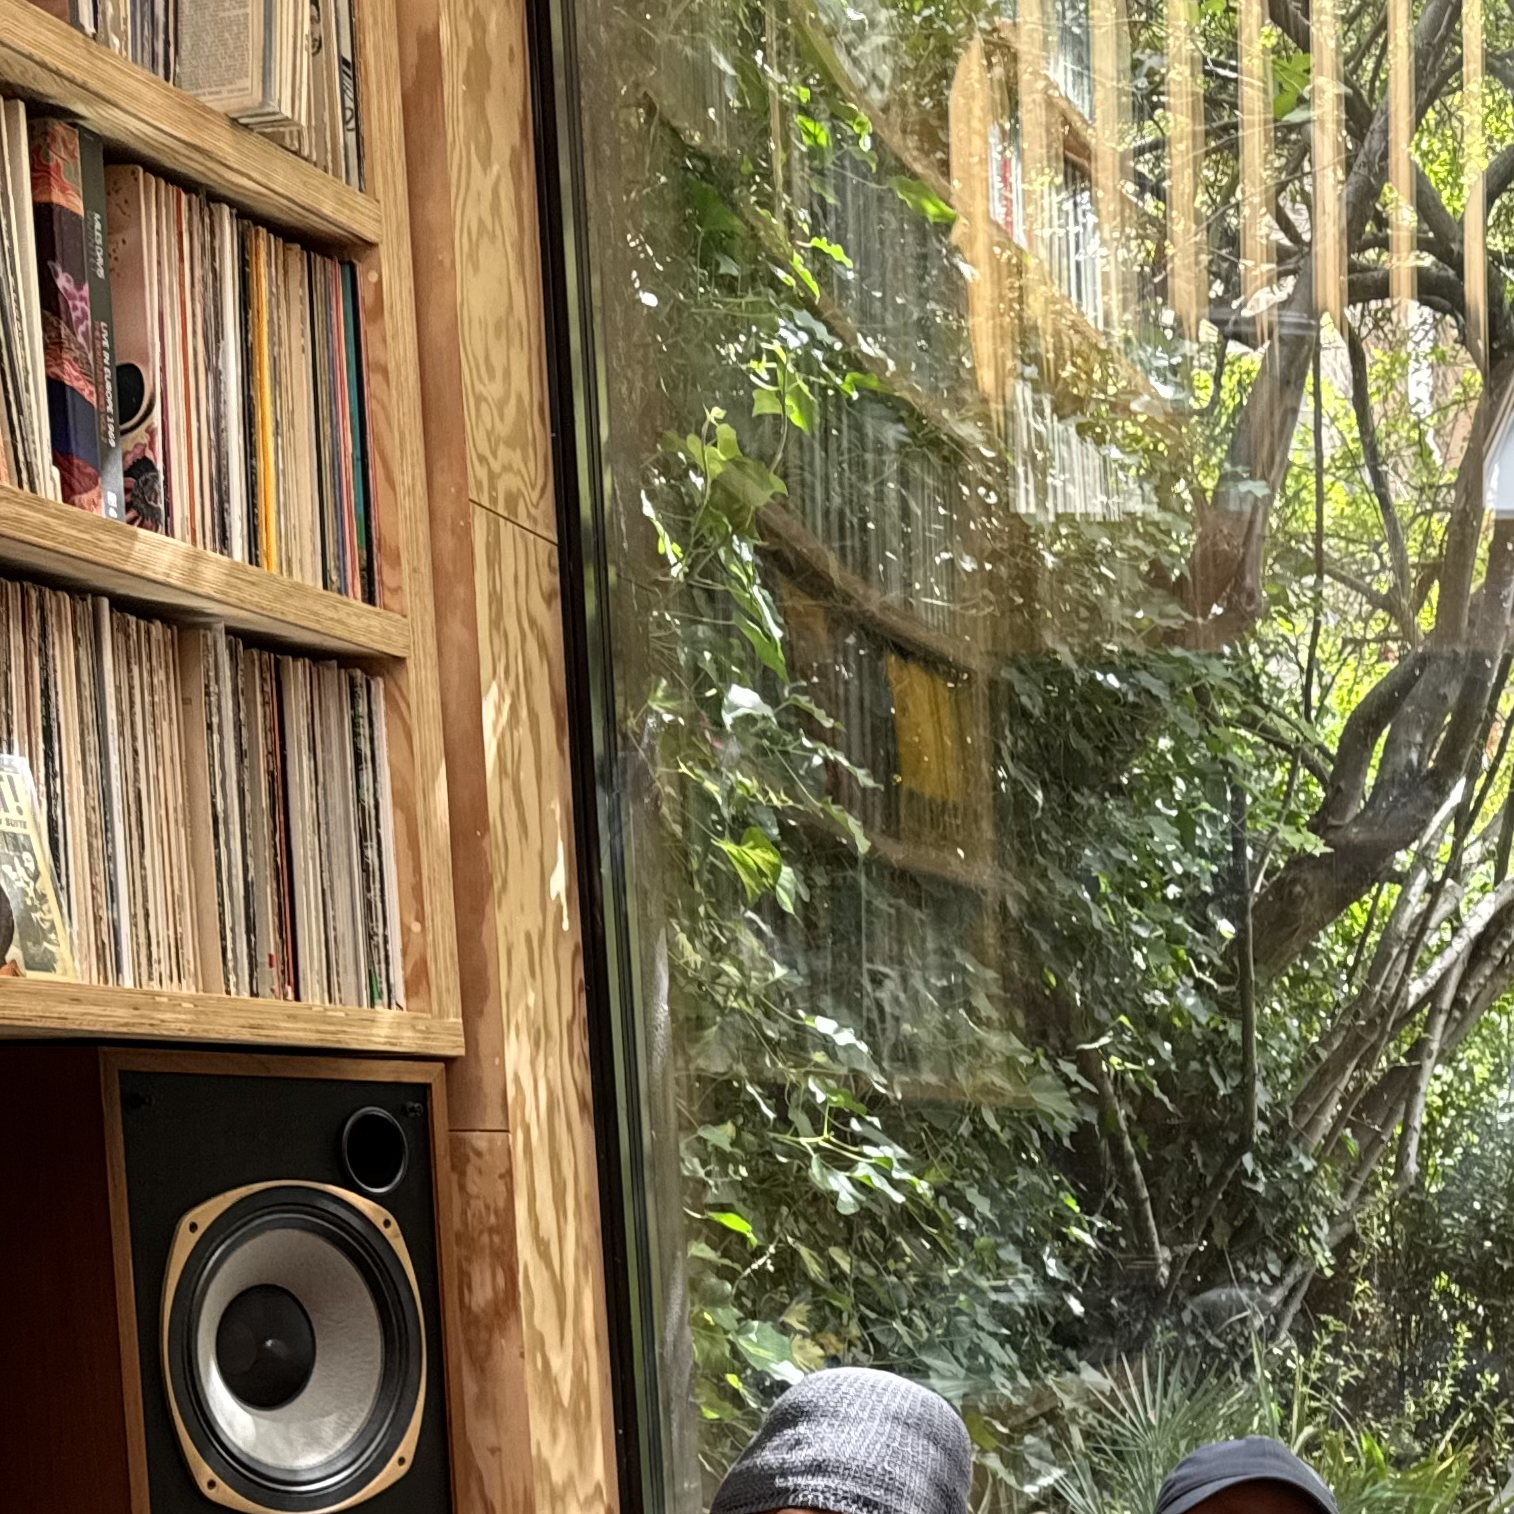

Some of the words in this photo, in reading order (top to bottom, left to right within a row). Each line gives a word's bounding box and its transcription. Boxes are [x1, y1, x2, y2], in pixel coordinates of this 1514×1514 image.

[94, 212, 103, 246] MILES
[96, 246, 105, 280] DAVIS
[101, 321, 110, 348] LIVE
[103, 350, 111, 366] IN
[104, 366, 114, 414] EUROPE
[107, 415, 116, 448] 1969
